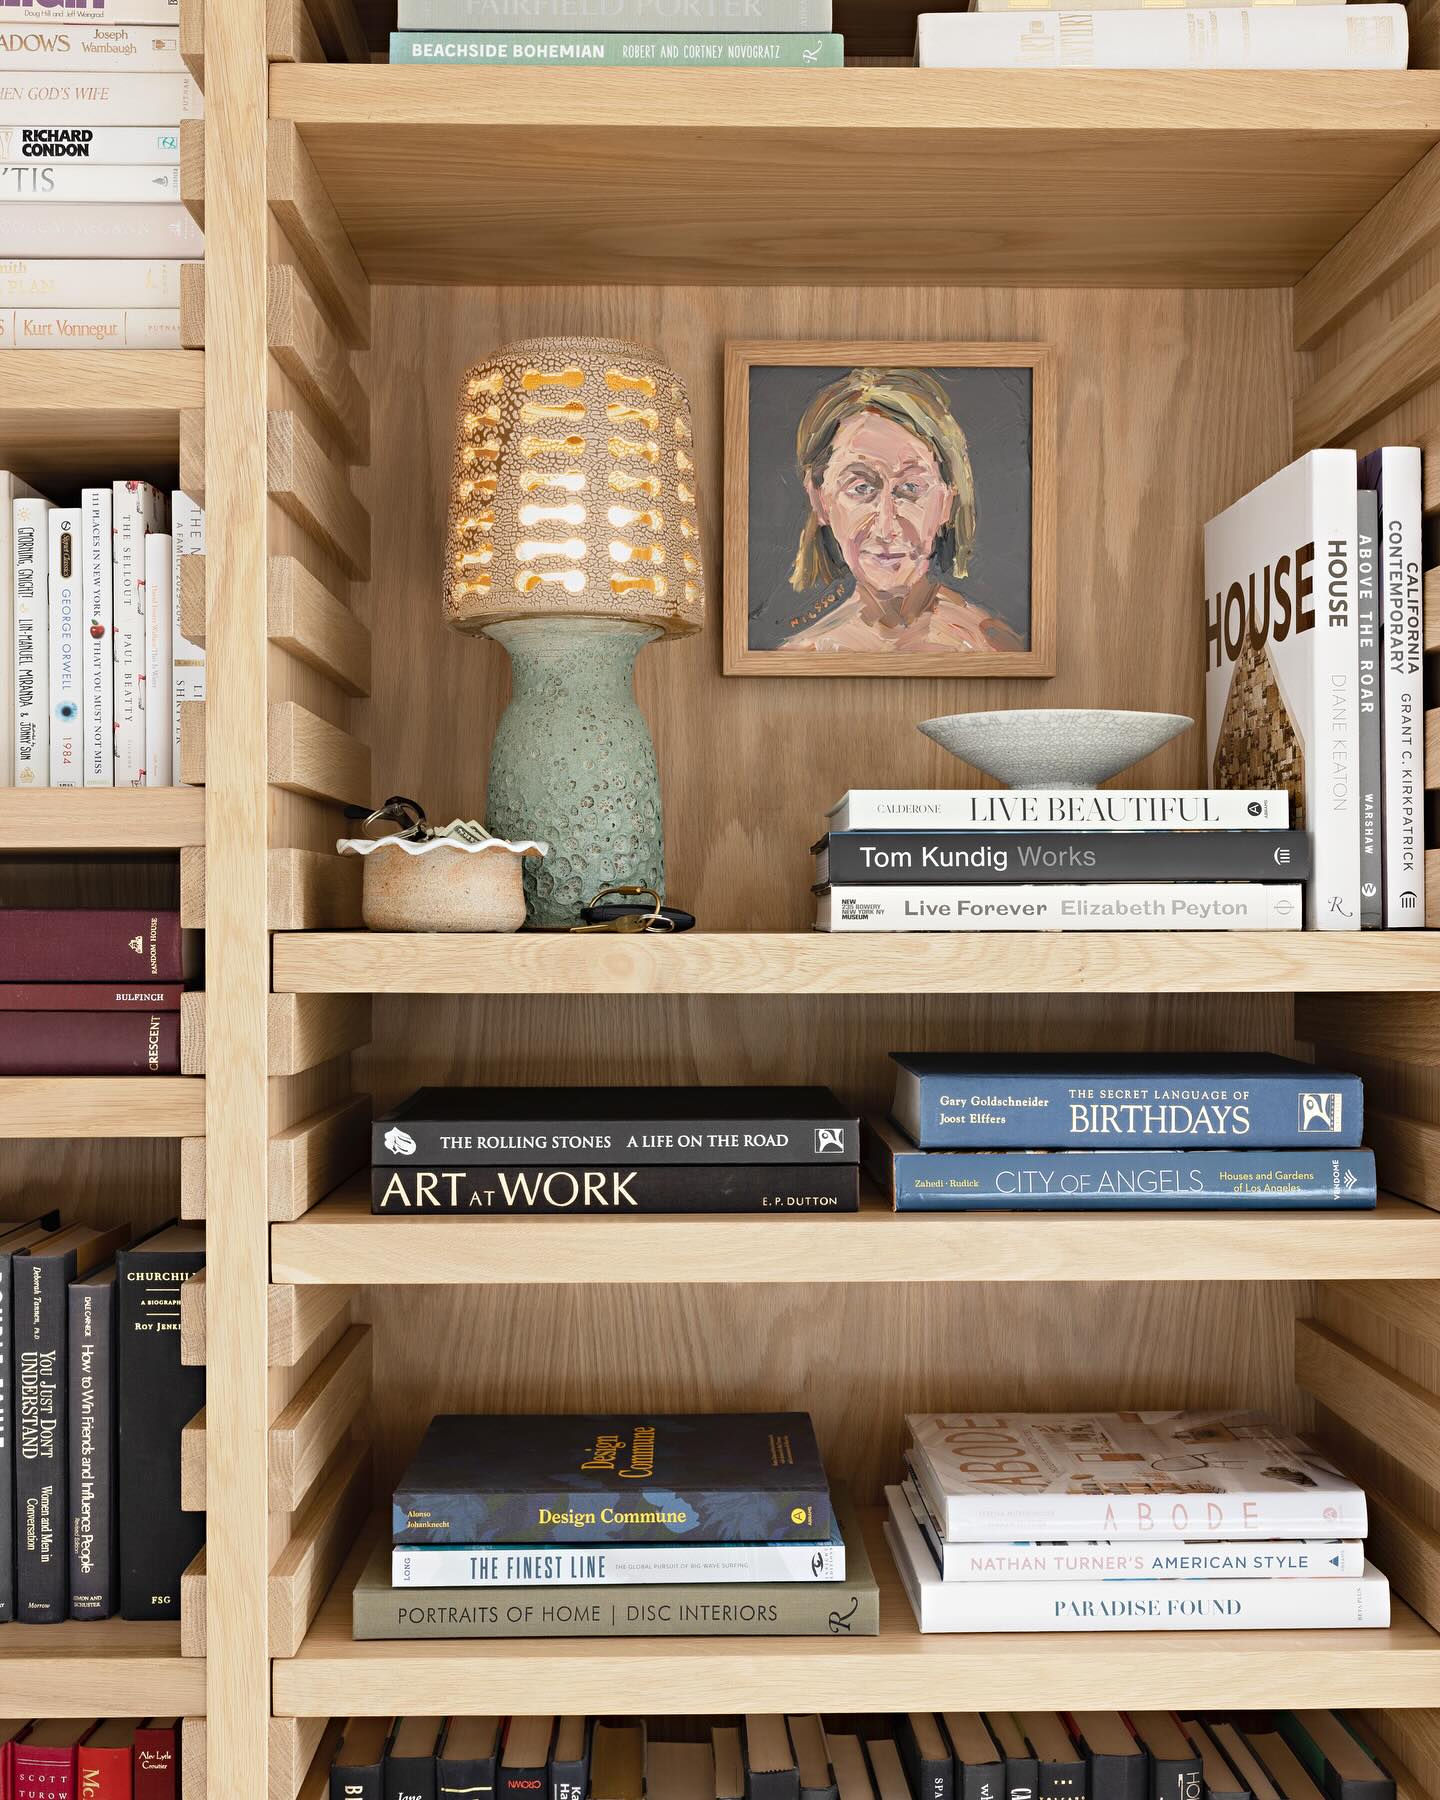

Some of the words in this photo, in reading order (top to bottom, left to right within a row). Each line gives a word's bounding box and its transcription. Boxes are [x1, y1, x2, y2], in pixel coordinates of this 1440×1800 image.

[93, 29, 128, 41] Joseph
[82, 42, 136, 55] Wambaugh
[412, 44, 507, 57] BEACHSIDE
[513, 44, 605, 58] BOHEMIAN
[623, 45, 655, 58] ROBERT
[661, 45, 678, 58] AND
[684, 45, 723, 58] CORTNEY
[728, 45, 780, 58] NOVOGRATZ
[28, 87, 70, 100] GOD'S
[75, 88, 110, 100] WIFE
[22, 130, 93, 142] RICHARD
[22, 143, 89, 157] CONDON
[24, 320, 52, 336] Kurt
[56, 319, 118, 340] Vonnegut
[93, 549, 100, 560] IN
[123, 548, 132, 605] SELLOUT
[1359, 534, 1373, 600] ABOVE
[1328, 540, 1348, 627] HOUSE
[1205, 541, 1315, 673] HOUSE
[1389, 520, 1404, 675] CONTEMPORARY
[62, 589, 71, 639] GEORGE
[1407, 562, 1419, 674] CALIFORNIA
[1360, 612, 1373, 648] THE
[62, 644, 72, 690] ORWELL
[19, 670, 33, 707] MIRANDA
[1360, 660, 1374, 712] ROAR
[94, 695, 102, 723] MUST
[1331, 675, 1347, 732] DIANE
[1400, 693, 1412, 745] GRANT
[20, 747, 31, 760] SUN
[63, 737, 72, 764] 1984
[1401, 750, 1412, 765] C.
[1332, 741, 1348, 811] KEATON
[877, 804, 942, 814] CALDERONE
[970, 798, 1038, 821] LIVE
[1048, 798, 1219, 821] BEAUTIFUL
[1402, 769, 1414, 871] KIRKPATRICK
[1365, 794, 1373, 854] WARSHAW
[860, 847, 912, 867] Tom
[922, 847, 1008, 871] Kundig
[1017, 846, 1096, 866] Works
[905, 900, 951, 916] Live
[958, 900, 1047, 916] Forever
[1061, 900, 1165, 916] Elizabeth
[1171, 900, 1248, 918] Peyton
[148, 1016, 161, 1070] CRESCENT
[940, 1096, 967, 1108] Gary
[971, 1096, 1049, 1107] Goldschneider
[1068, 1090, 1094, 1098] THE
[1100, 1090, 1148, 1099] SECRET
[1154, 1090, 1227, 1100] LANGUAGE
[1233, 1091, 1249, 1100] OF
[940, 1114, 965, 1125] Joost
[970, 1114, 1006, 1124] Elffers
[1070, 1104, 1249, 1134] BIRTHDAYS
[440, 1137, 472, 1149] THE
[477, 1136, 547, 1149] ROLLING
[552, 1136, 612, 1148] STONES
[626, 1136, 638, 1147] A
[642, 1136, 673, 1147] LIFE
[677, 1135, 702, 1147] ON
[707, 1135, 739, 1147] THE
[744, 1134, 788, 1147] ROAD
[915, 1179, 944, 1188] Zahedi
[950, 1179, 980, 1187] Rudick
[995, 1171, 1055, 1193] CITY
[1061, 1175, 1091, 1193] OF
[1097, 1170, 1203, 1193] ANGELS
[1220, 1172, 1253, 1180] Houses
[1256, 1171, 1272, 1180] and
[1275, 1171, 1314, 1180] Gardens
[380, 1173, 466, 1206] ART
[470, 1190, 495, 1206] AT
[497, 1172, 638, 1206] WORK
[1234, 1184, 1242, 1192] of
[1245, 1184, 1262, 1192] Los
[1264, 1184, 1301, 1194] Angeles
[762, 1197, 772, 1206] E.
[775, 1197, 784, 1206] P.
[787, 1197, 837, 1205] DUTTON
[33, 1267, 41, 1294] Deborah
[82, 1345, 94, 1371] How
[82, 1377, 92, 1388] to
[21, 1352, 38, 1459] UNDERSTAND
[82, 1390, 94, 1414] Win
[82, 1417, 95, 1455] Friends
[581, 1435, 626, 1469] Design
[618, 1426, 655, 1478] Commune
[936, 1419, 1052, 1487] ABODE
[82, 1459, 95, 1477] and
[41, 1485, 52, 1517] Women
[81, 1479, 95, 1532] Influence
[27, 1498, 38, 1550] Conversation
[41, 1519, 52, 1532] and
[538, 1509, 596, 1527] Design
[601, 1508, 686, 1524] Commune
[1104, 1502, 1259, 1531] ABODE
[41, 1534, 52, 1553] Men
[81, 1534, 94, 1573] People
[470, 1557, 498, 1580] THE
[507, 1556, 562, 1579] FINEST
[571, 1556, 606, 1578] LINE
[971, 1557, 1046, 1570] NATHAN
[1054, 1556, 1144, 1570] TURNER'S
[1152, 1557, 1246, 1569] AMERICAN
[1253, 1556, 1308, 1568] STYLE
[399, 1607, 498, 1624] PORTRAITS
[506, 1606, 533, 1622] OF
[543, 1606, 600, 1621] HOME
[627, 1606, 670, 1621] DISC
[679, 1605, 777, 1620] INTERIORS
[1055, 1600, 1160, 1616] PARADISE
[1168, 1600, 1241, 1615] FOUND
[20, 1774, 68, 1783] SCOTT
[20, 1790, 68, 1800] TUROW
